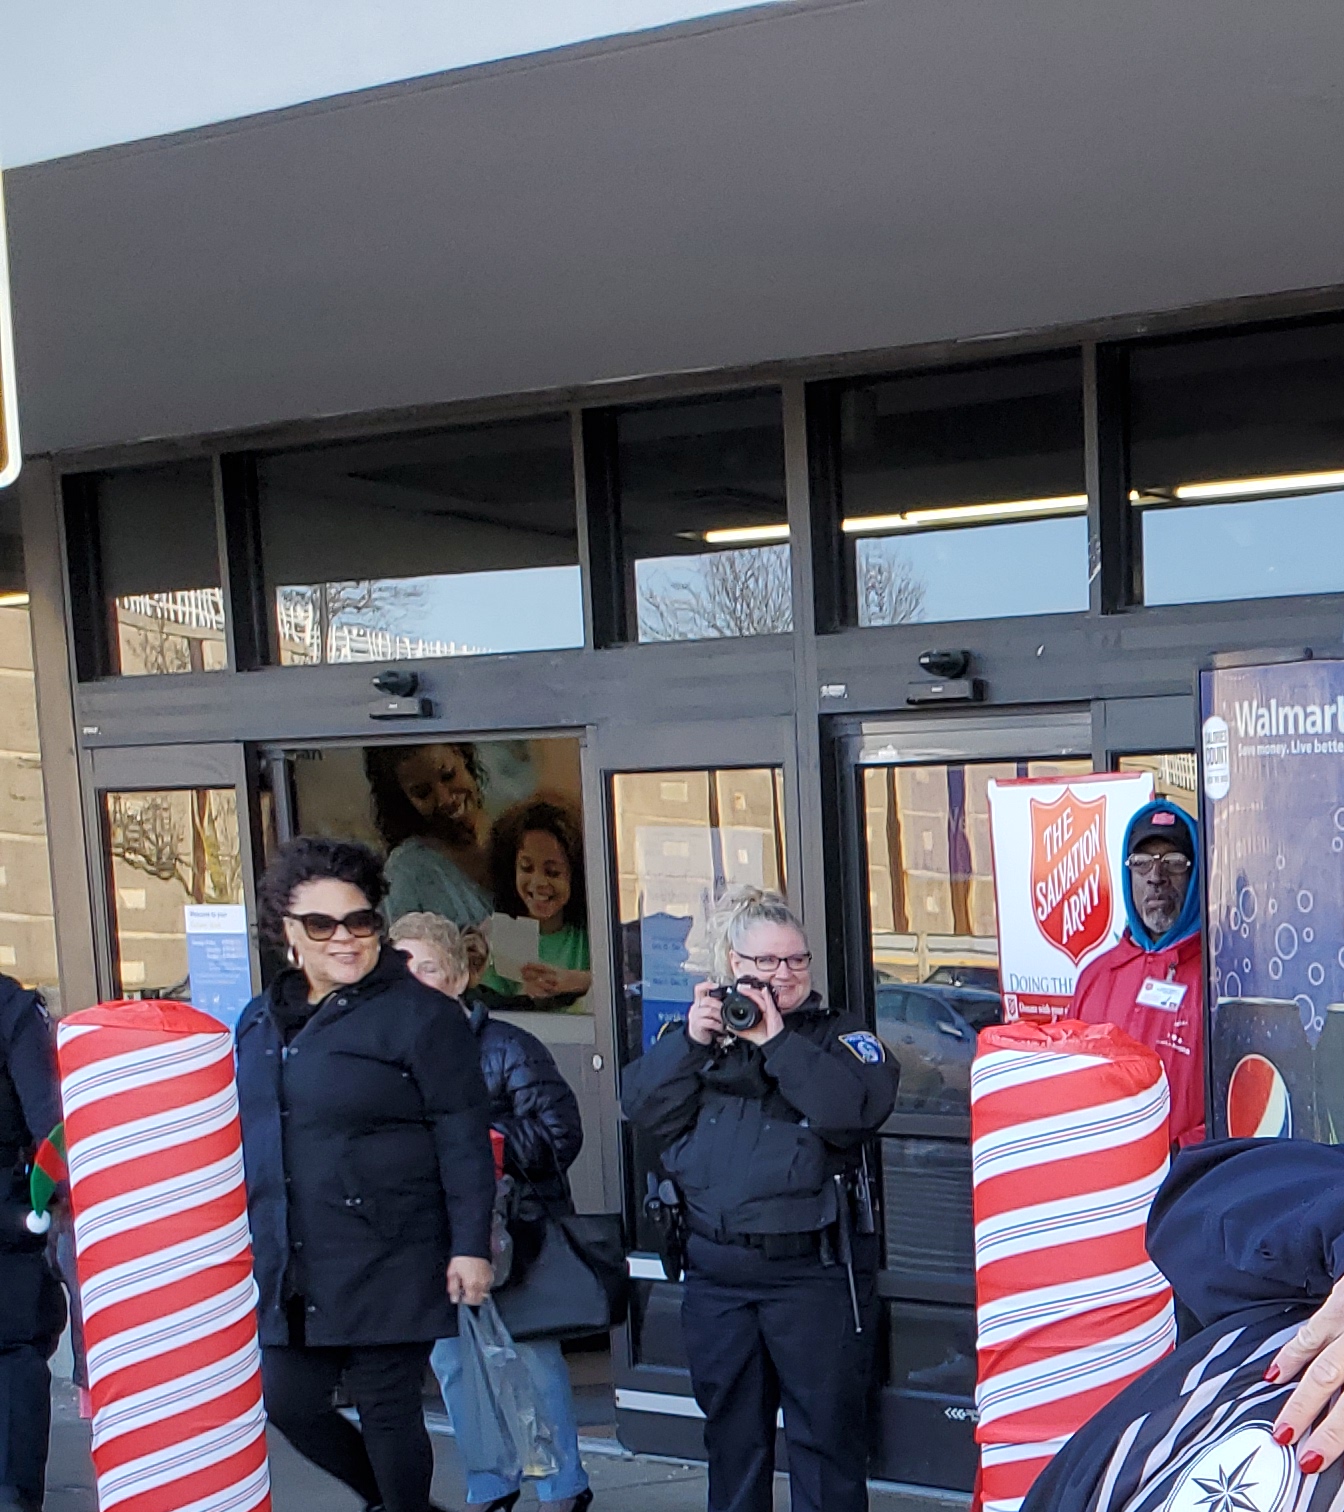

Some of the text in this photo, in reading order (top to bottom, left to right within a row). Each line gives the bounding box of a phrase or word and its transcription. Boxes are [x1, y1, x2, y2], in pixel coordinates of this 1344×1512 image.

[1290, 739, 1312, 755] Live
[1043, 807, 1074, 863] THE
[1036, 814, 1100, 922] SALVATION
[1062, 864, 1100, 945] ARMY
[1010, 973, 1049, 993] DOING
